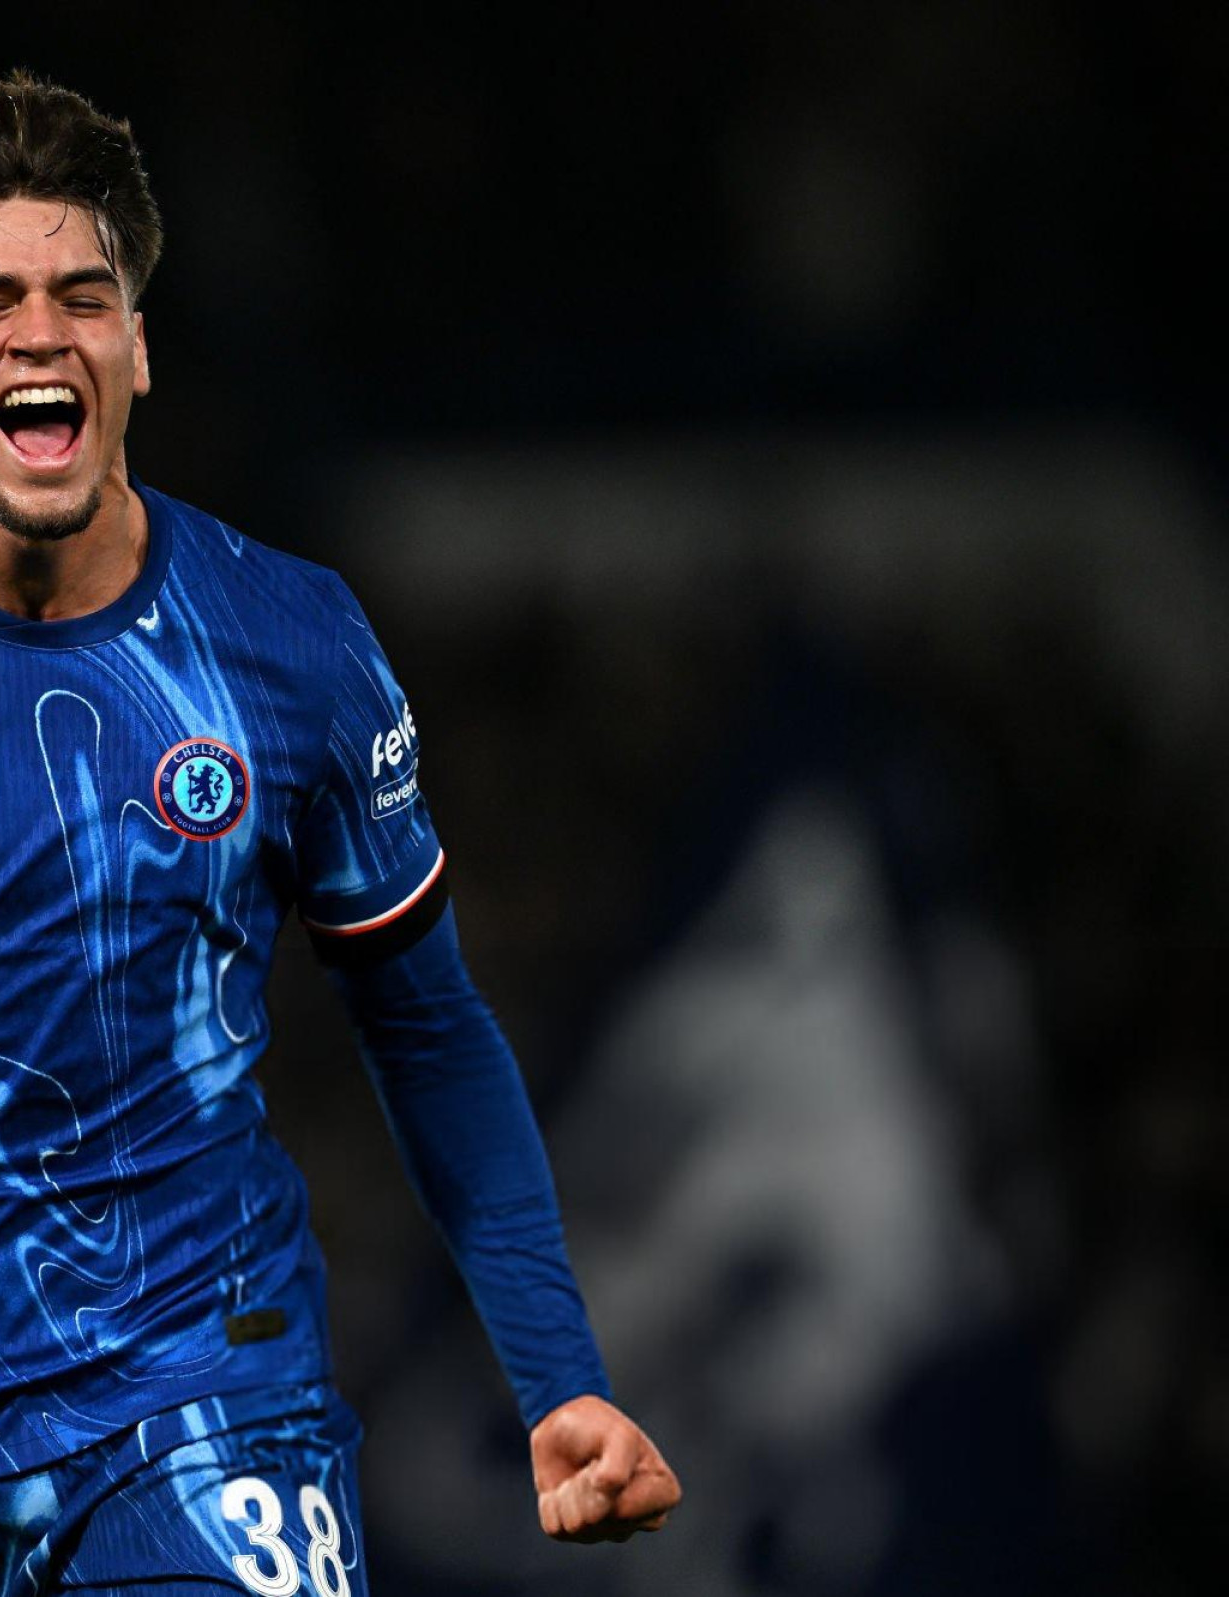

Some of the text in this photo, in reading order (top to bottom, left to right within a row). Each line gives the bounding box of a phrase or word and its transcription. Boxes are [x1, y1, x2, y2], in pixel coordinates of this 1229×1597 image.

[173, 744, 232, 765] CHELSEA
[172, 814, 233, 833] FOOTBALL CLUB
[221, 1477, 352, 1597] 38
